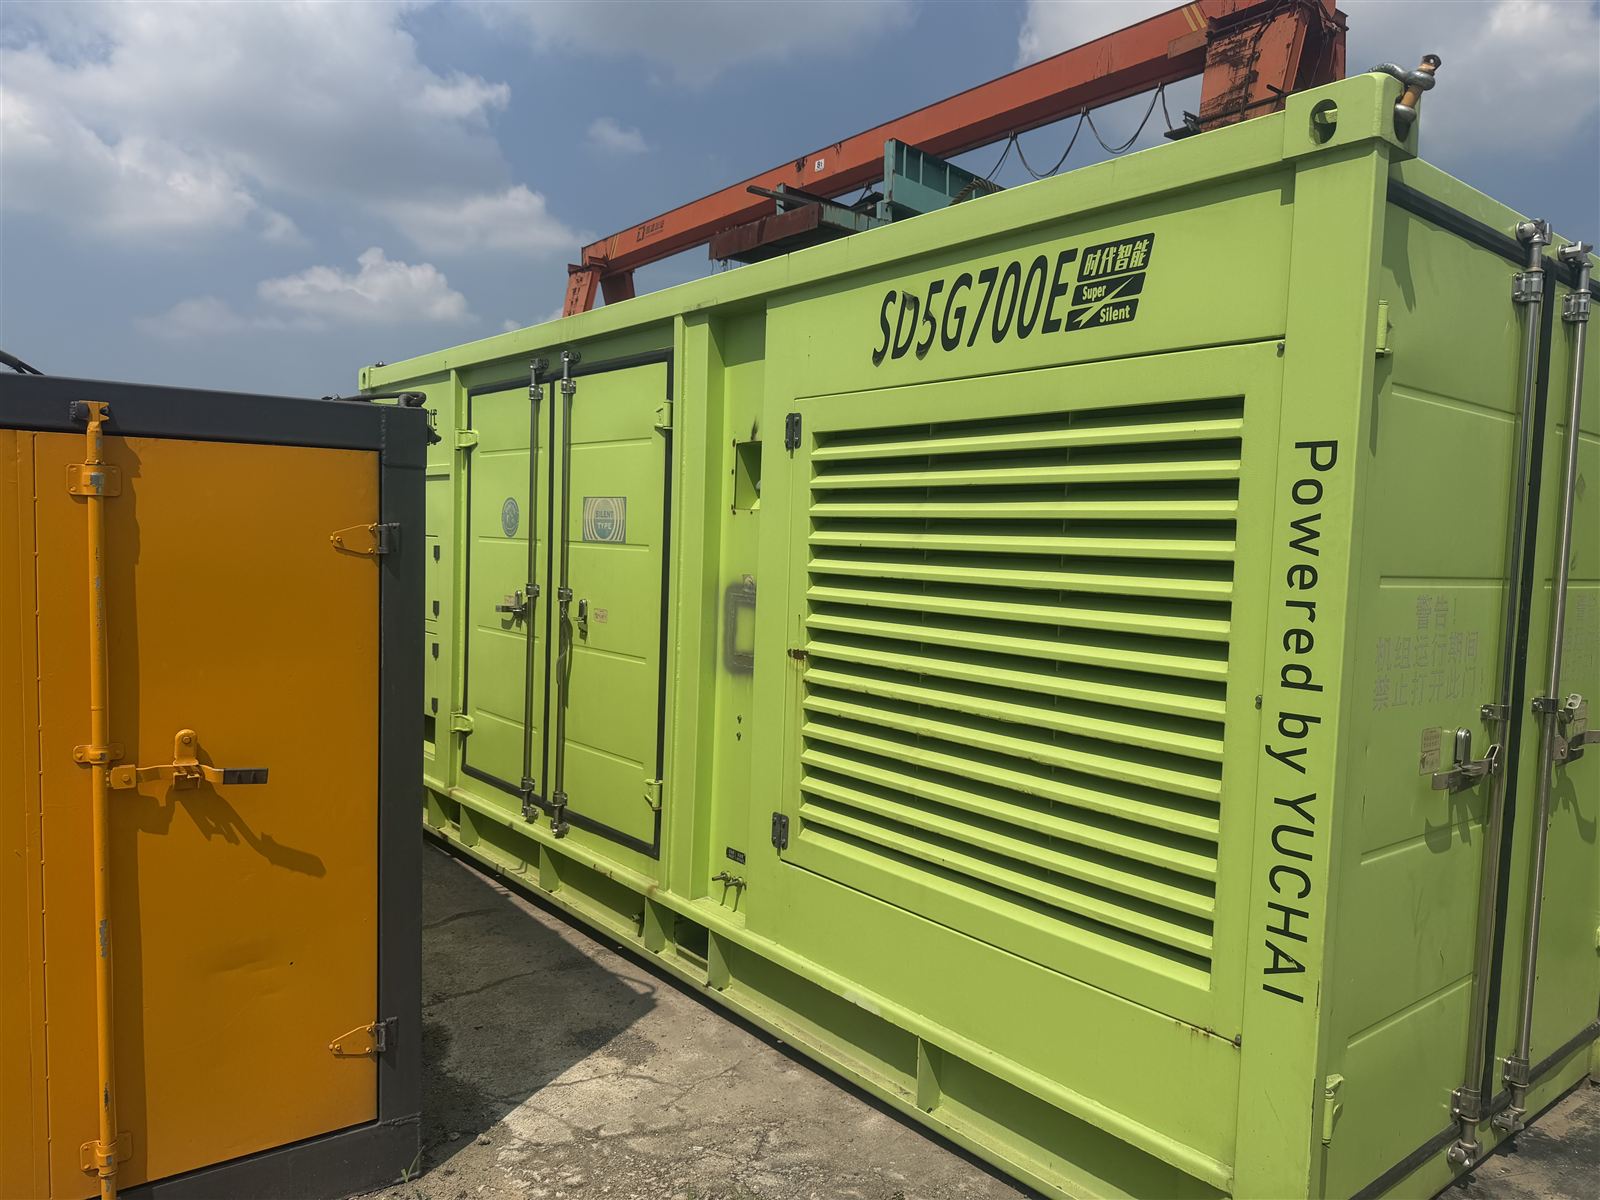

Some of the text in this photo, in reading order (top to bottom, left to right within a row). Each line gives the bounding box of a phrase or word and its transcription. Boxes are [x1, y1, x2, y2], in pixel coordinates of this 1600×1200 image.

[1083, 239, 1150, 276] 时代智能
[872, 248, 1078, 367] SD5G700E
[1082, 284, 1107, 301] Super
[1100, 304, 1130, 323] Silent
[1262, 440, 1338, 1003] Powered by YUCHAI
